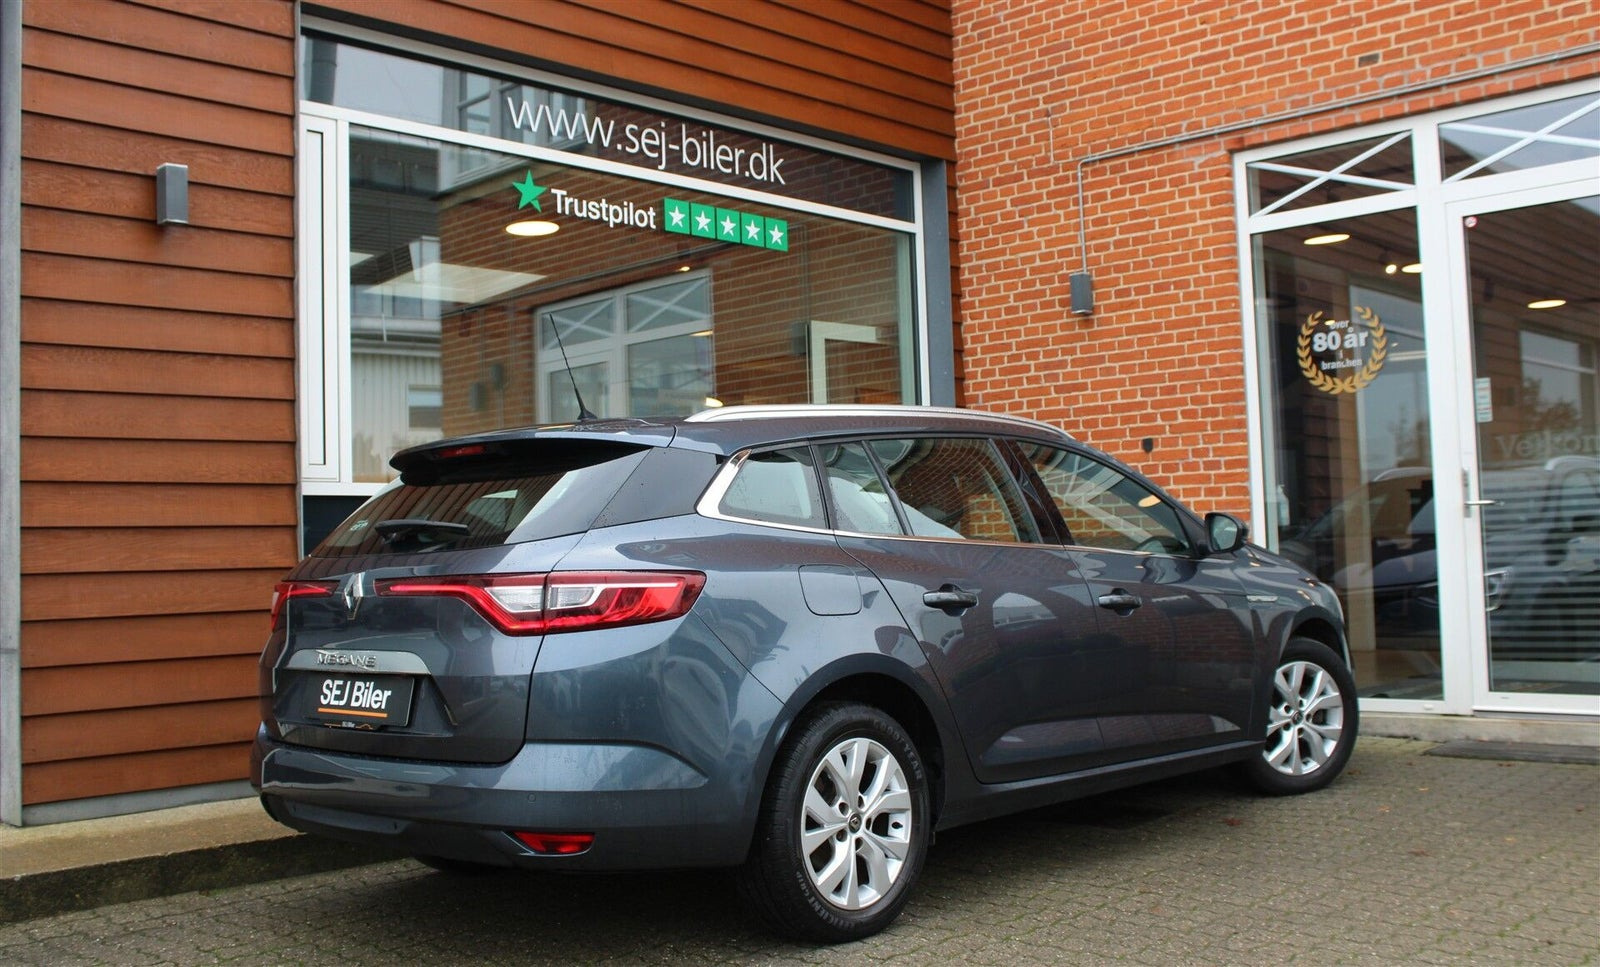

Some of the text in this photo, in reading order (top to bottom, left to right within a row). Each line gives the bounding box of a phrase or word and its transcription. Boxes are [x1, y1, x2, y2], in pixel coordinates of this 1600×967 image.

[507, 96, 786, 186] www.sej-biler.dk
[550, 188, 657, 230] Trustpilot
[1313, 326, 1369, 352] 80 år
[320, 679, 392, 710] SEJ Biler
